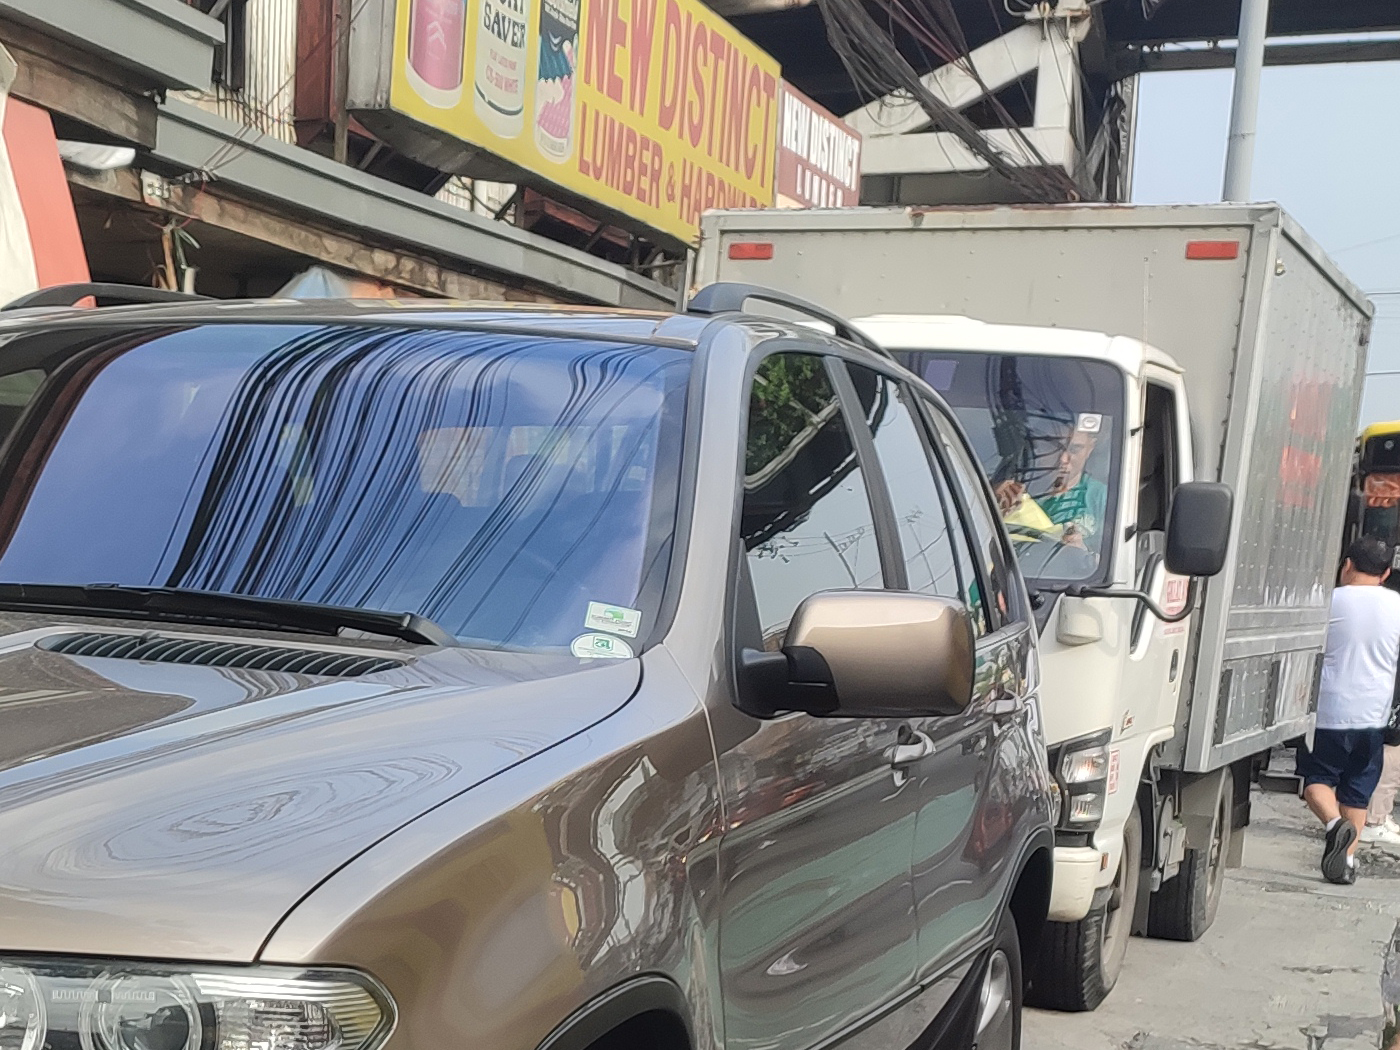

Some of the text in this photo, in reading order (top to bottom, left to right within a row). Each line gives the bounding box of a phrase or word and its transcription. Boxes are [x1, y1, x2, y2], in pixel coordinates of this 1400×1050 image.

[484, 3, 526, 49] SAVER
[584, 0, 776, 188] NEW DISTINCT
[578, 101, 663, 209] LUMBER
[666, 161, 675, 203] &
